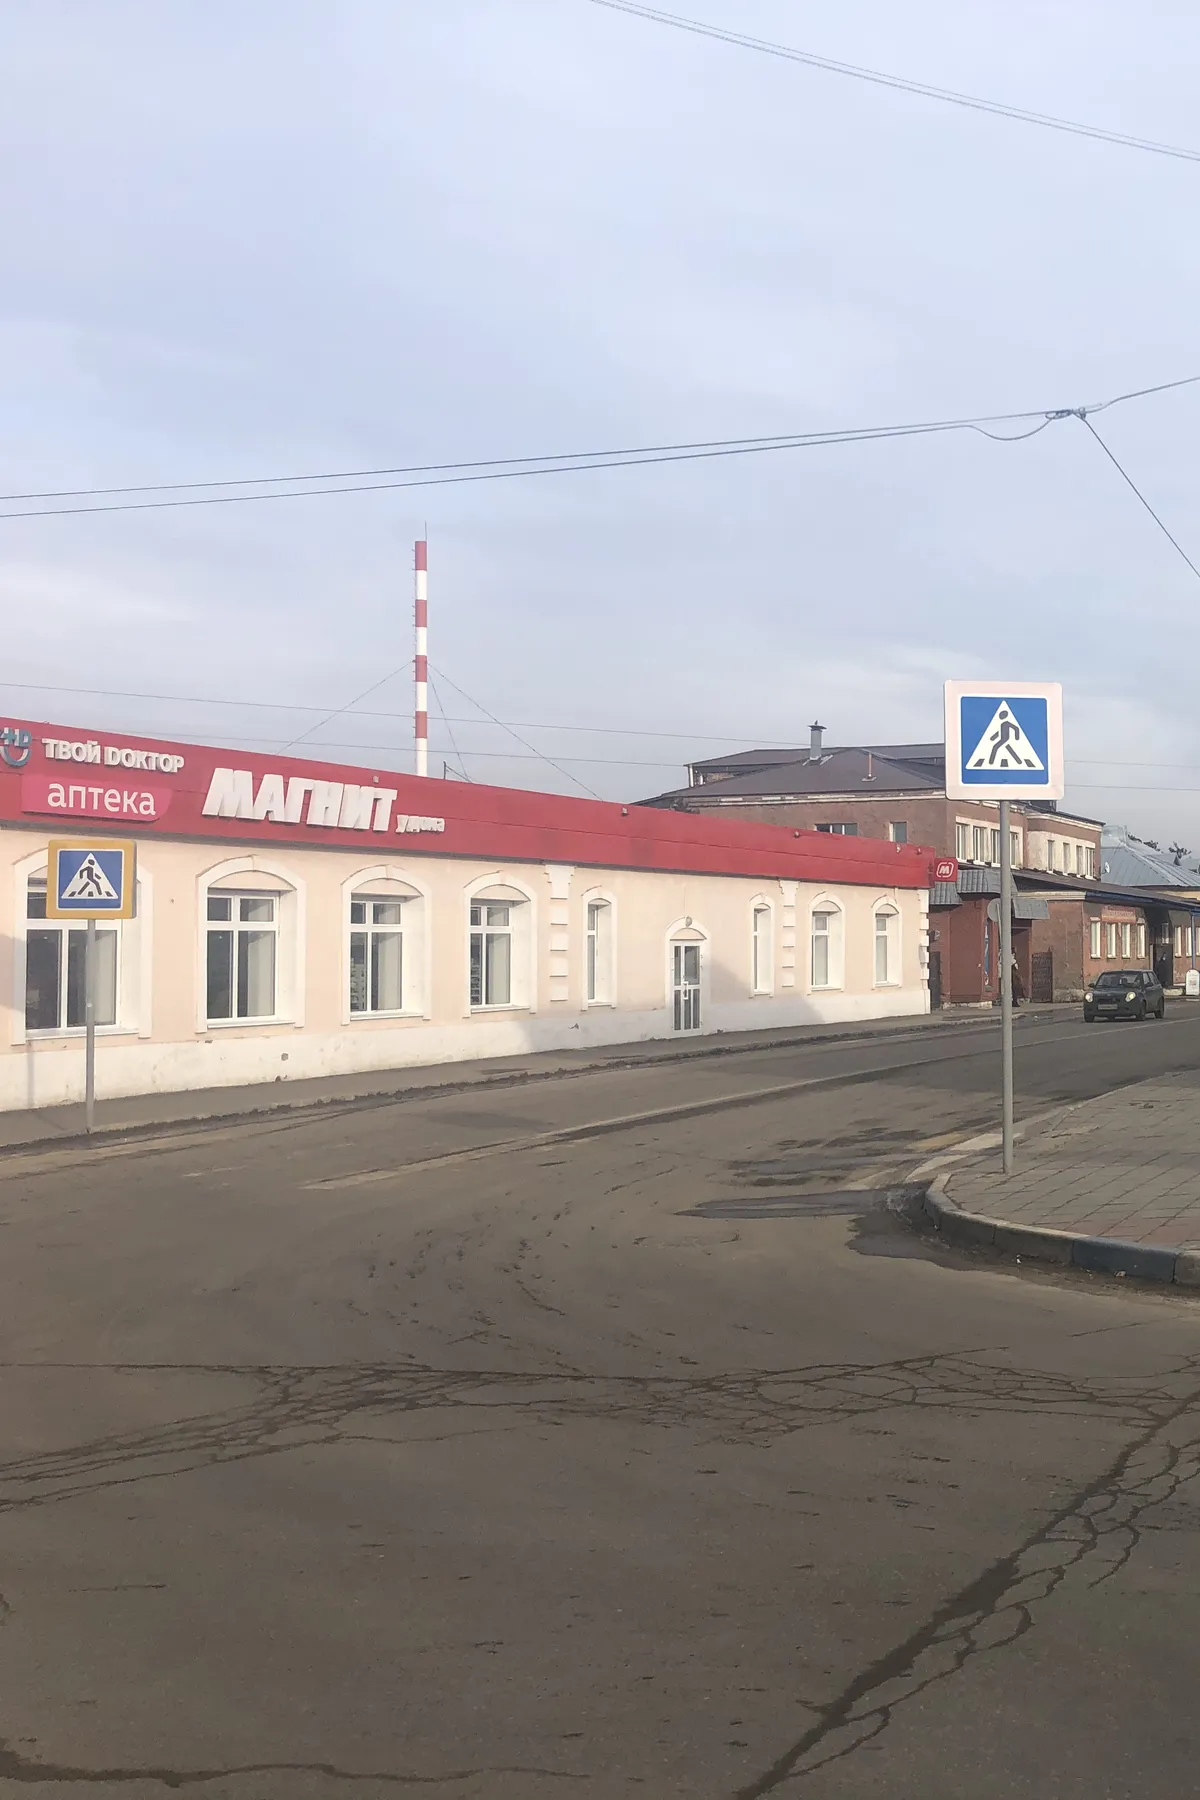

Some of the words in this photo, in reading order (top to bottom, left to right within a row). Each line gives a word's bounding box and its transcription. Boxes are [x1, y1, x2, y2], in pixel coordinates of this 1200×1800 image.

[42, 738, 101, 764] ТВОЙ
[47, 783, 156, 816] аптека
[202, 768, 398, 832] МАГНИТ
